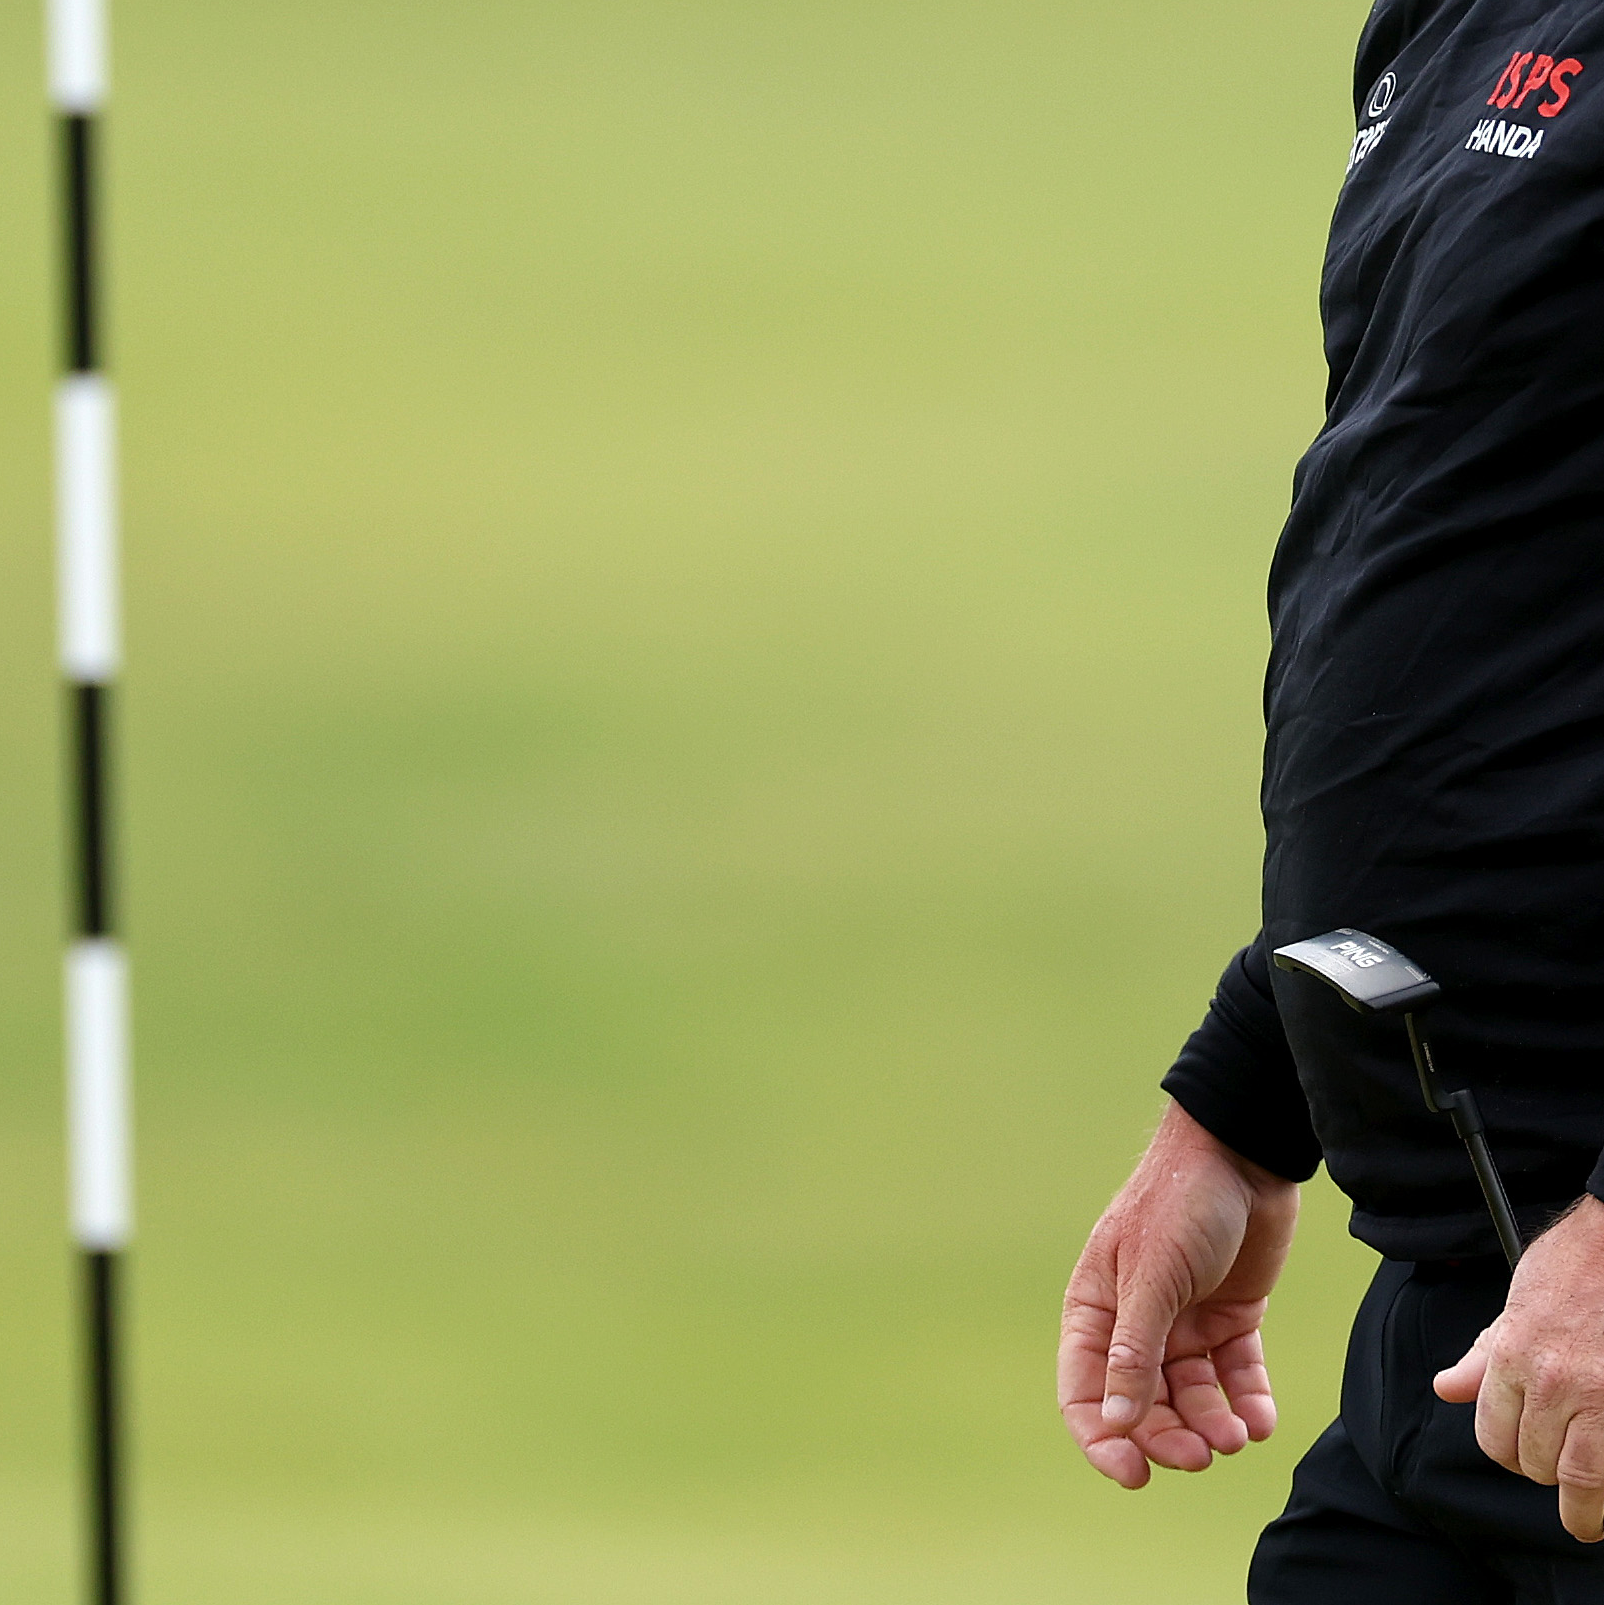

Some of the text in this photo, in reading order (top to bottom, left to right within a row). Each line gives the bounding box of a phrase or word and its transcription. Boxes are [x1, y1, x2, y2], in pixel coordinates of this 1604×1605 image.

[1486, 51, 1584, 118] ISPS
[1465, 119, 1544, 159] HANDA
[1329, 941, 1384, 968] PING
